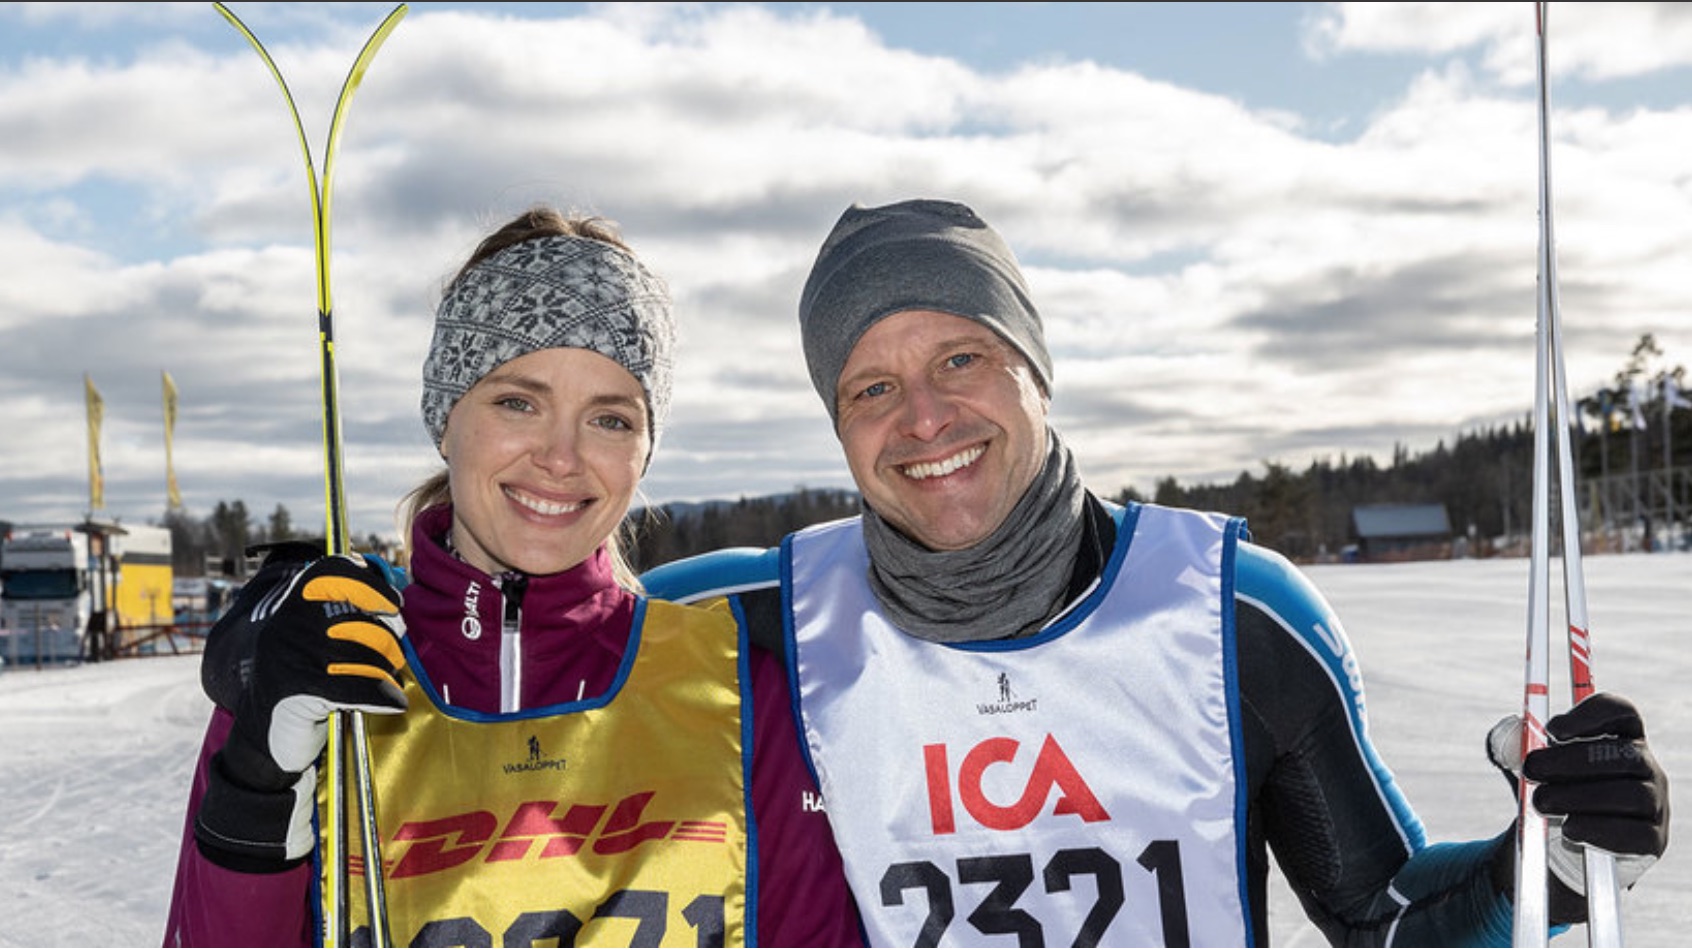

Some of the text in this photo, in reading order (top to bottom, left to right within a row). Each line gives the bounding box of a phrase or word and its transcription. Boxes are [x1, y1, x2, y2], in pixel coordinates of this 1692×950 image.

[975, 699, 1038, 715] VASALOPPET
[503, 759, 566, 774] VASALOPPET
[923, 732, 1111, 835] ICA
[389, 791, 676, 879] DHL
[879, 839, 1191, 948] 2321
